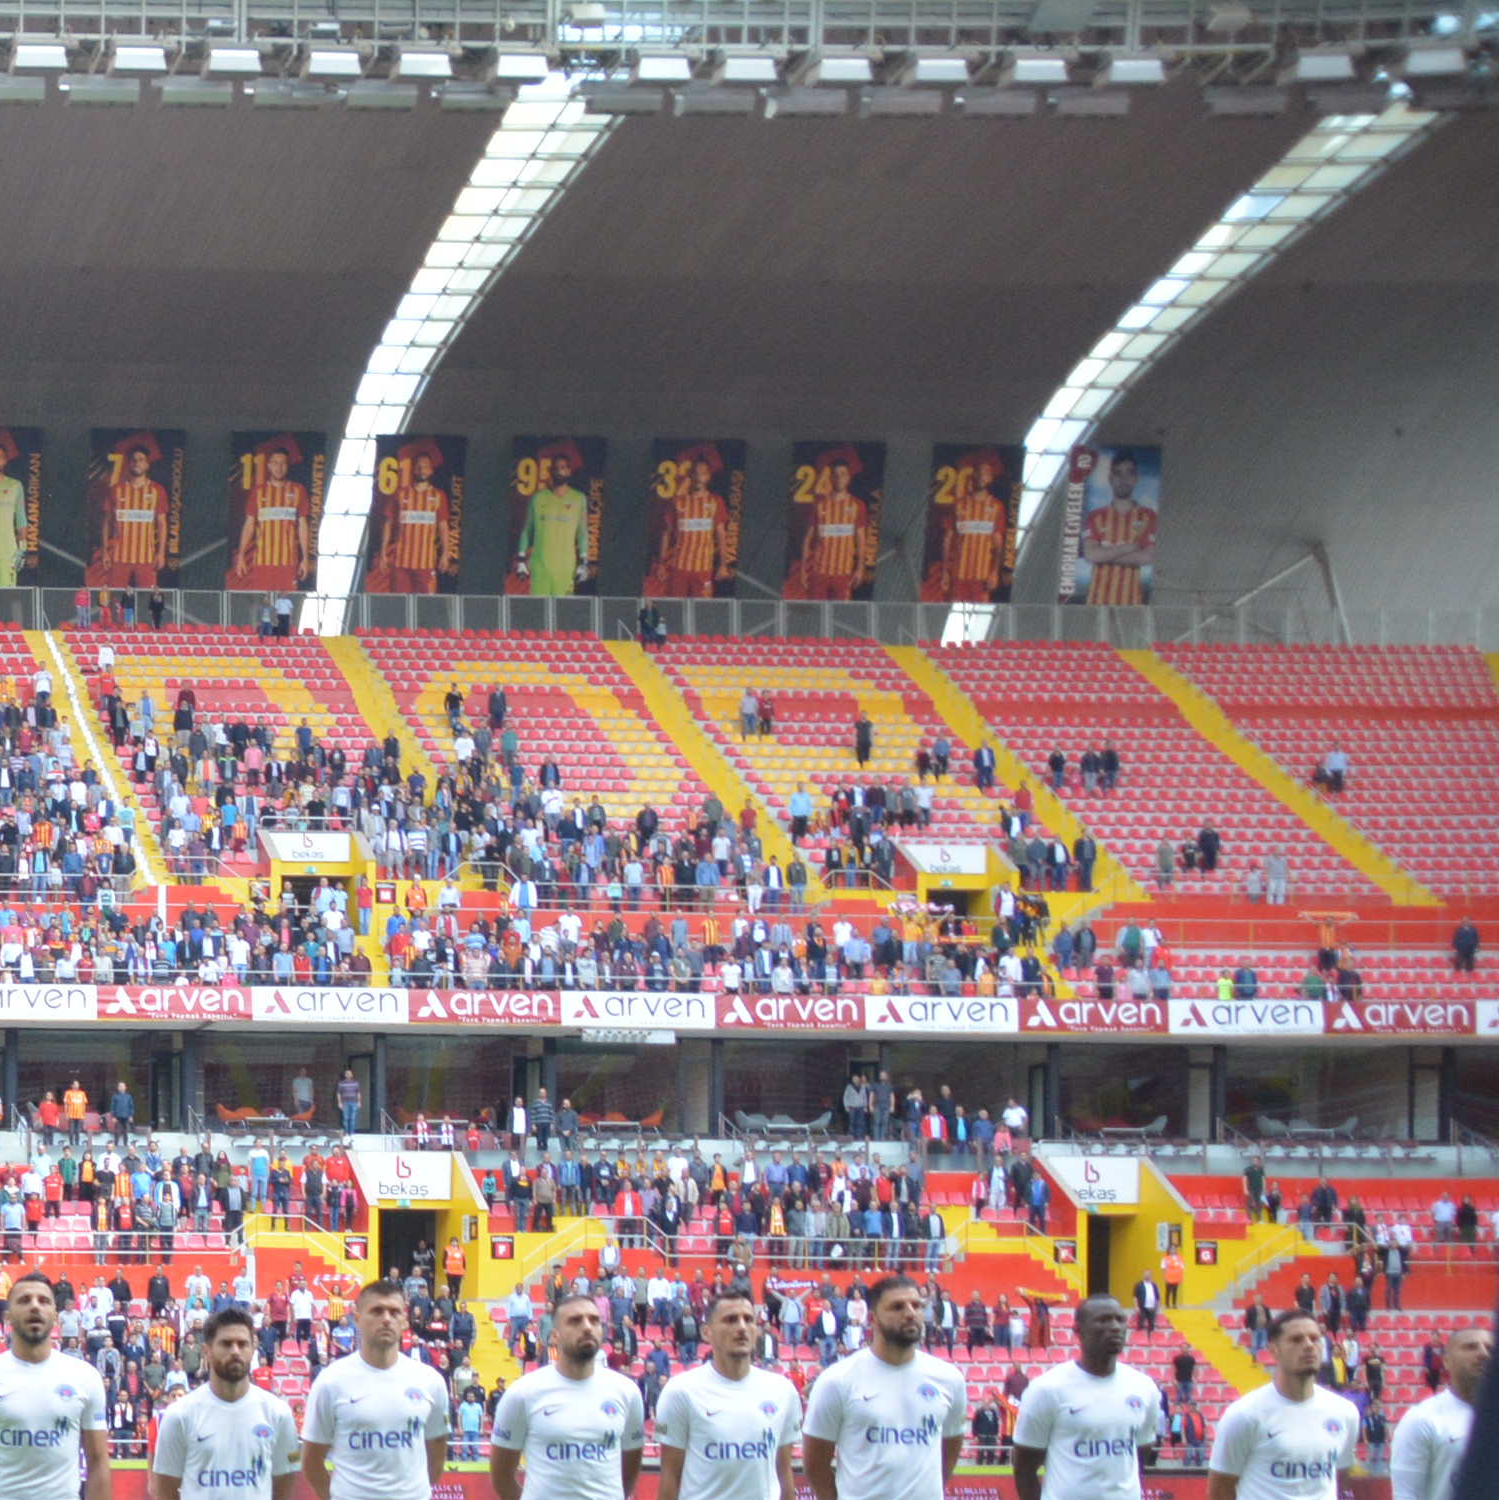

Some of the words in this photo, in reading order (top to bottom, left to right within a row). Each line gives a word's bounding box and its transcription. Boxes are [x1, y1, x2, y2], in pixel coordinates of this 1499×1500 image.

[107, 453, 124, 487] 7
[240, 453, 266, 490] 11
[377, 456, 412, 496] 61
[138, 986, 245, 1012] arven
[296, 989, 398, 1013] arven
[450, 990, 555, 1017] arven
[604, 993, 706, 1020] arven
[755, 996, 859, 1021] arven
[908, 998, 1009, 1024] arven
[1059, 999, 1162, 1025] arven
[1212, 1000, 1314, 1026] arven
[1364, 1000, 1469, 1027] arven
[378, 1181, 429, 1198] bekaş
